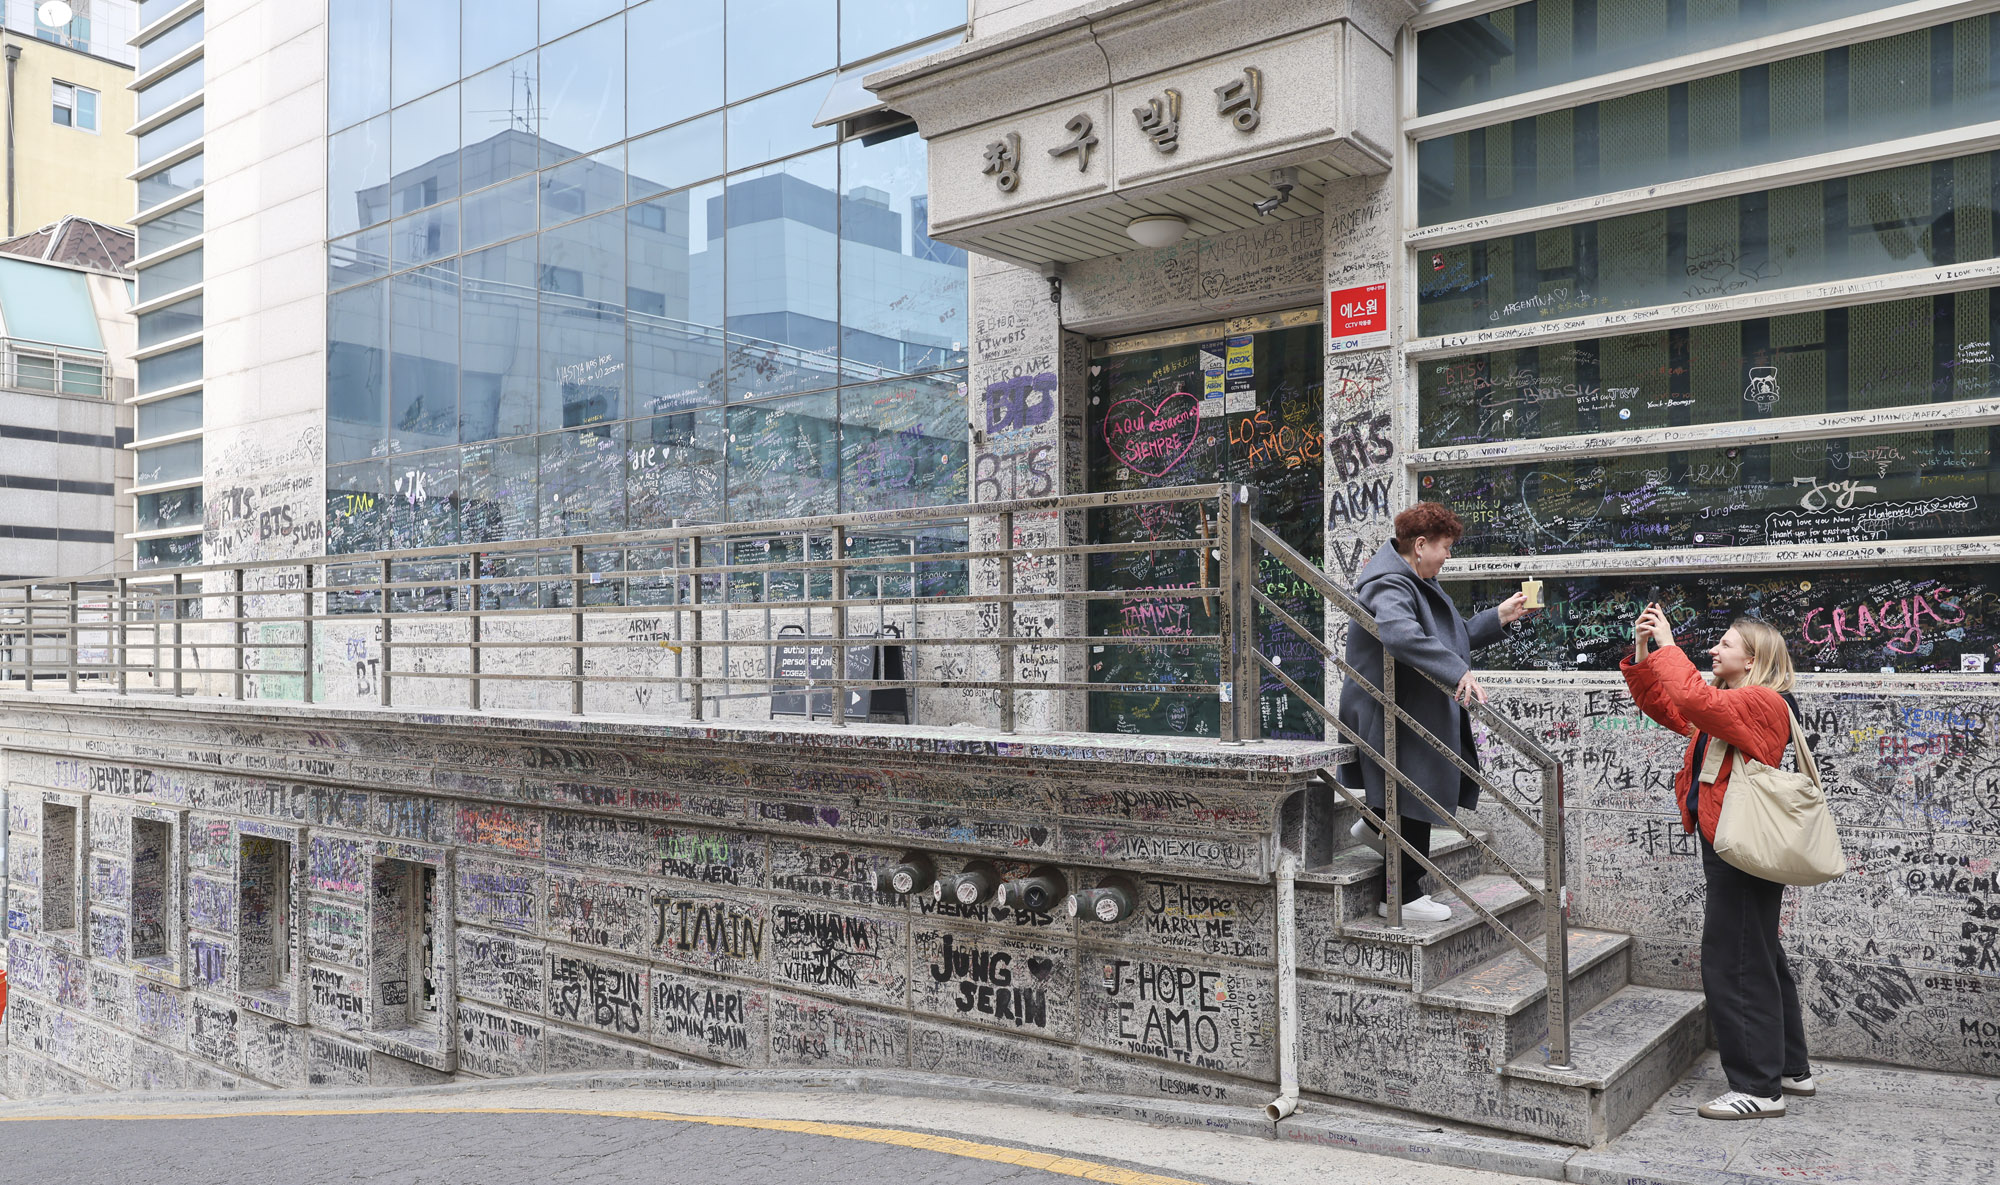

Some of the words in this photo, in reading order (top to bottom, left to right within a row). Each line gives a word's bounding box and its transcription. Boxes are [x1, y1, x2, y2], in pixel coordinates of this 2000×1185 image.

[1329, 206, 1381, 237] ARMENIA
[1252, 227, 1283, 249] WAS
[1340, 299, 1377, 318] 에스원
[1503, 292, 1553, 315] ARGENTINA
[1605, 314, 1626, 324] ALEX
[1008, 329, 1025, 343] BTS
[1332, 341, 1358, 350] SECOM
[1446, 362, 1476, 385] BTS
[1576, 396, 1589, 404] BTS
[1149, 406, 1199, 432] estaremos
[1228, 410, 1273, 445] LOS
[1126, 433, 1183, 461] SIEMPRE
[1248, 425, 1295, 469] AMO
[1678, 461, 1745, 483] ARMY
[260, 481, 290, 498] WELCOME
[292, 477, 313, 490] HOME
[405, 470, 428, 500] JK
[344, 493, 368, 518] JM
[1104, 492, 1118, 504] BTS
[1328, 476, 1393, 531] ARMY
[1452, 500, 1487, 511] THANK
[260, 504, 294, 540] BTS
[292, 519, 324, 545] SUGA
[1770, 529, 1793, 538] thank
[1794, 529, 1807, 537] you
[1809, 527, 1821, 536] for
[1796, 517, 1812, 526] love
[1815, 517, 1830, 526] you
[1776, 552, 1797, 560] ROSE
[629, 618, 660, 633] ARMY
[1019, 615, 1039, 625] LOVE
[1803, 588, 1965, 650] GRACIAS
[1024, 626, 1042, 637] JK
[783, 646, 823, 654] authozed
[1019, 654, 1040, 666] Abby
[820, 658, 832, 666] onl
[1022, 668, 1048, 681] Cathy
[1150, 839, 1221, 859] MEXICO
[662, 858, 697, 880] PARK
[653, 896, 765, 962] JIMIN
[1146, 917, 1201, 938] MARRY
[1206, 920, 1233, 938] ME
[931, 934, 1012, 986] JUNG
[1306, 939, 1413, 979] YEONJUN
[311, 969, 343, 990] ARMY
[583, 964, 640, 1004] YEJIN
[1106, 961, 1221, 1013] J-HOPE
[1925, 978, 1982, 993] 아포방포
[337, 996, 363, 1013] JEN
[659, 982, 700, 1016] PARK
[457, 1008, 485, 1025] ARMY
[511, 1020, 534, 1037] JEN
[595, 992, 643, 1034] BTS
[479, 1030, 509, 1050] JIMIN
[1143, 1005, 1219, 1054] AMO
[1128, 1041, 1169, 1059] YOONGI
[1173, 1049, 1191, 1064] TE
[1196, 1055, 1225, 1070] AMO
[1215, 1087, 1227, 1099] JK
